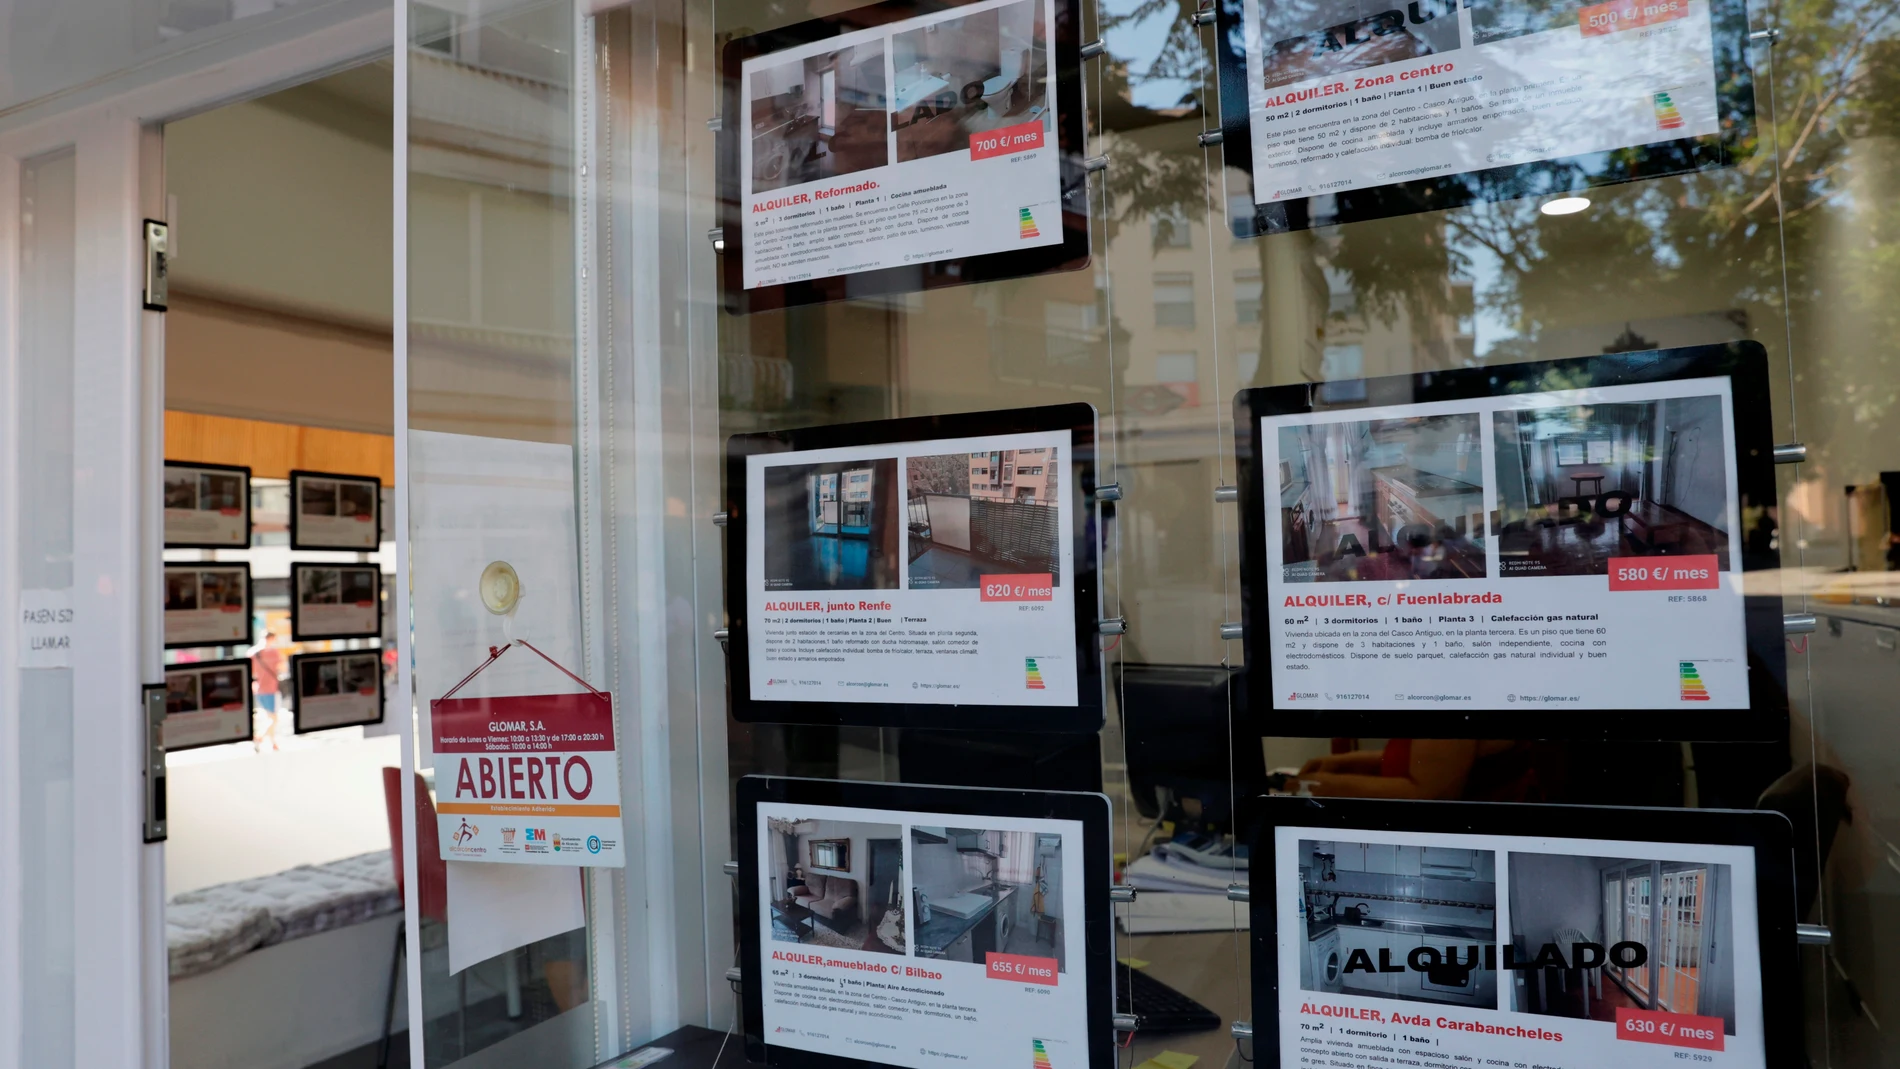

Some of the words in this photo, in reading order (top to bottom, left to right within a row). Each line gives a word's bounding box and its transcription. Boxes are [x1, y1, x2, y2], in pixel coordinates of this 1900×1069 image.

[1589, 11, 1619, 28] 500
[1643, 1, 1679, 16] mes
[1265, 82, 1349, 109] ALQUILER.
[1354, 74, 1394, 90] Zona
[1399, 63, 1454, 81] centro
[1265, 114, 1276, 123] 50
[1276, 111, 1290, 120] m2
[1302, 101, 1348, 115] dormitorios
[1361, 94, 1382, 103] baño
[1388, 88, 1416, 98] Planta
[1429, 81, 1452, 90] Buen
[976, 138, 997, 152] 700
[1013, 132, 1037, 145] mes
[1388, 162, 1452, 179] alcorcon@glomar.es
[1318, 178, 1353, 190] 916127014
[752, 193, 811, 214] ALQUILER,
[814, 180, 880, 201] Reformado.
[1618, 567, 1648, 581] 580
[1673, 568, 1709, 580] mes
[986, 584, 1011, 597] 620
[1028, 587, 1051, 597] mes
[1284, 594, 1372, 608] ALQUILER,
[1377, 593, 1391, 606] c/
[1397, 591, 1502, 605] Fuenlabrada
[1667, 595, 1686, 603] REF:
[1687, 595, 1708, 603] 5868
[764, 601, 824, 613] ALQUILER,
[826, 601, 856, 613] junto
[858, 600, 892, 611] Renfe
[1284, 617, 1295, 625] 60
[1323, 617, 1330, 625] 3
[1331, 616, 1379, 625] dormitorios
[1394, 616, 1399, 624] 1
[1401, 616, 1423, 624] baño
[1438, 615, 1467, 623] Planta
[1468, 615, 1475, 623] 3
[1490, 614, 1545, 622] Calefacción
[1546, 615, 1564, 623] gas
[1565, 613, 1599, 621] natural
[1284, 630, 1314, 638] Vivienda
[1314, 630, 1341, 638] ubicada
[1390, 629, 1414, 637] Casco
[1414, 629, 1444, 638] Antiguo,
[1464, 628, 1488, 637] planta
[1541, 628, 1558, 637] piso
[30, 635, 71, 650] LLAMAR
[1312, 642, 1339, 650] dispone
[1371, 641, 1416, 649] habitaciones
[1444, 640, 1465, 648] baño,
[1471, 640, 1492, 648] salón
[1498, 639, 1553, 649] independiente,
[1285, 652, 1346, 660] electrodomésticos.
[1350, 651, 1379, 661] Dispone
[1393, 651, 1414, 659] suelo
[1416, 652, 1446, 660] parquet,
[1448, 651, 1490, 659] calefacción
[1510, 651, 1537, 659] natural
[1539, 651, 1576, 659] individual
[1587, 650, 1608, 659] buen
[1406, 694, 1472, 702] alcorcon@glomar.es
[1519, 694, 1581, 703] https://glomar.es/
[488, 720, 529, 732] GLOMAR,
[529, 720, 546, 731] S.A.
[439, 736, 459, 744] Horario
[487, 735, 509, 743] Viernes:
[510, 734, 525, 743] 10:00
[530, 734, 546, 742] 13:30
[551, 734, 560, 742] de
[560, 733, 577, 742] 17:00
[582, 733, 599, 741] 20:30
[485, 743, 511, 751] Sábados:
[511, 742, 527, 750] 10:00
[532, 742, 548, 750] 14:00
[456, 755, 593, 801] ABIERTO
[1342, 940, 1648, 974] ALQUILADO
[772, 950, 888, 973] ALQULER,amueblado
[890, 965, 902, 975] C/
[905, 966, 942, 980] Bilbao
[992, 961, 1012, 973] 655
[1028, 967, 1052, 978] mes
[1024, 986, 1037, 994] REF:
[1036, 988, 1051, 996] 6090
[1300, 1002, 1386, 1025] ALQUILER,
[1390, 1012, 1431, 1027] Avda
[1436, 1017, 1563, 1042] Carabancheles
[1625, 1018, 1655, 1034] 630
[1680, 1027, 1715, 1040] mes
[1300, 1023, 1311, 1031] 70
[1338, 1027, 1344, 1035] 1
[1345, 1028, 1388, 1039] dormitorio
[1402, 1034, 1407, 1042] 1
[1409, 1035, 1431, 1044] baño
[1299, 1035, 1323, 1045] Amplia
[1326, 1040, 1354, 1048] vivienda
[1357, 1043, 1395, 1053] amueblada
[1414, 1050, 1450, 1060] espacioso
[1453, 1054, 1473, 1063] salón
[1485, 1058, 1510, 1067] cocina
[1673, 1051, 1691, 1060] REF:
[1692, 1053, 1713, 1063] 5929
[1396, 1057, 1422, 1067] terraza,
